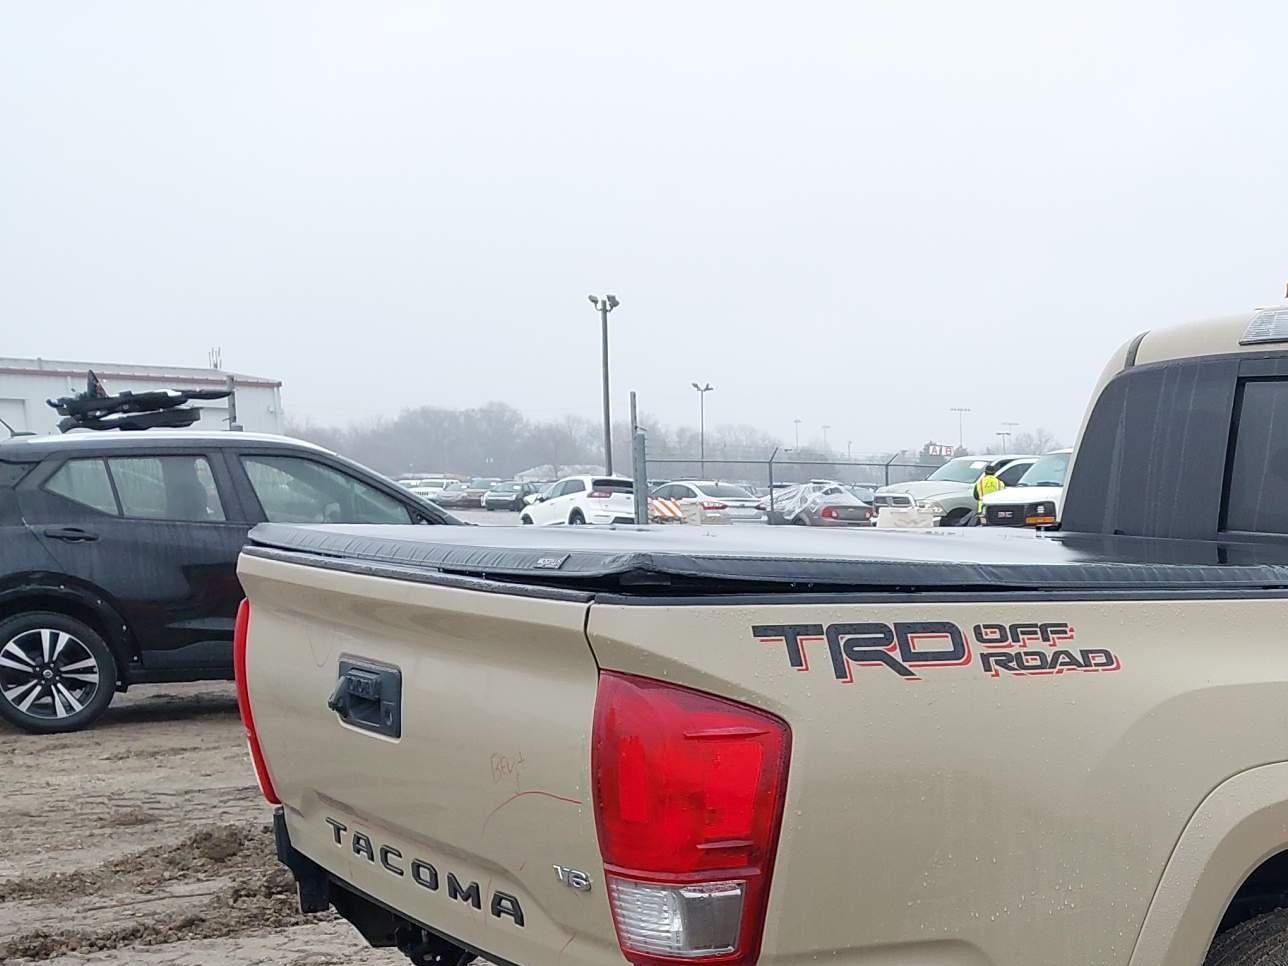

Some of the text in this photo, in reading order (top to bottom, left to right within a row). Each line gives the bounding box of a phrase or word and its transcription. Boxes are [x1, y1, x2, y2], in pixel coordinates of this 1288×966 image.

[751, 621, 1075, 684] TRD OFF
[979, 648, 1121, 677] ROAD
[326, 816, 525, 927] TACOMA
[553, 864, 592, 891] V6
